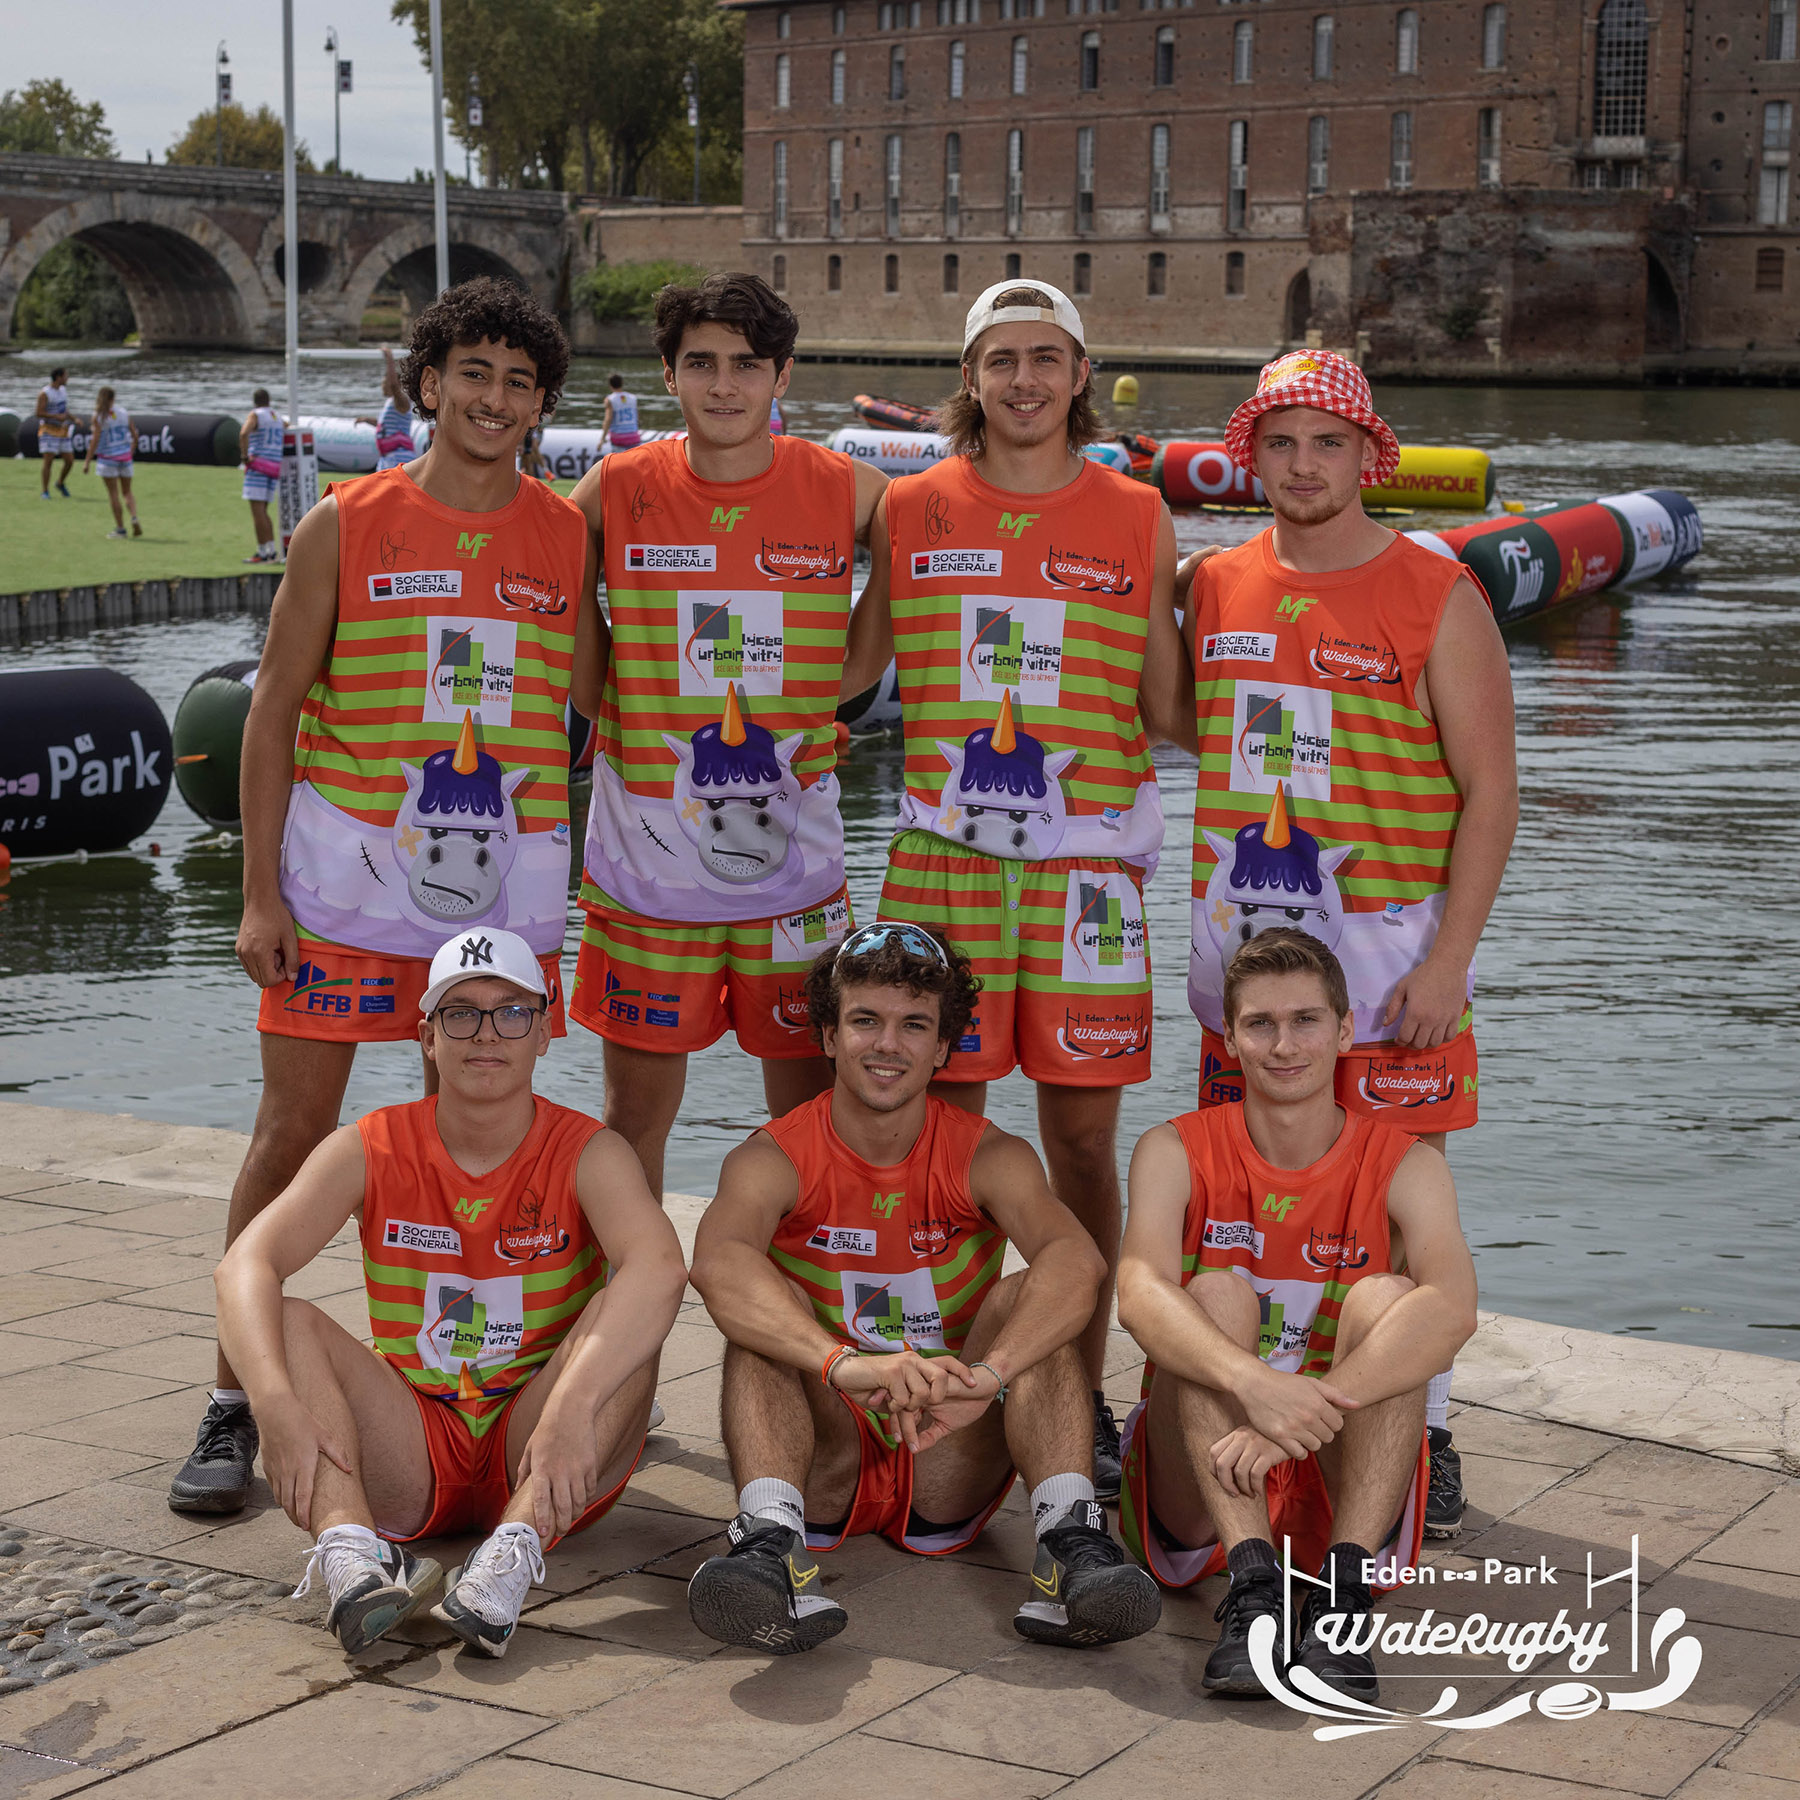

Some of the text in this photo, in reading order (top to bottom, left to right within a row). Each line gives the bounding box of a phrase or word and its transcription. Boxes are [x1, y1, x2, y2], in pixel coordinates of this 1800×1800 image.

[843, 441, 949, 459] Das WeltAu
[1381, 474, 1478, 493] OLYMPIQUE
[710, 506, 750, 532] MF
[998, 512, 1040, 538] MF
[456, 532, 493, 558] MF
[647, 548, 700, 558] SOCIETE
[777, 542, 820, 552] Eden Park
[647, 558, 712, 567] GENERALE
[769, 554, 831, 569] WateRugby
[932, 553, 985, 563] SOCIETE
[1066, 551, 1109, 566] Eden Park
[515, 572, 530, 581] Eden
[932, 563, 997, 573] GENERALE
[1055, 563, 1117, 584] WateRugby
[395, 574, 447, 585] SOCIETE
[396, 584, 458, 595] GENERALE
[1276, 595, 1319, 623] MF
[1217, 636, 1260, 646] SOCIETE
[1334, 638, 1378, 653] Eden Park
[698, 647, 744, 662] urbain
[1216, 646, 1271, 657] GENERALE
[978, 652, 1023, 669] urbain
[1322, 649, 1388, 674] WateRugby
[440, 673, 483, 690] urbain
[1249, 741, 1294, 761] urbain
[48, 730, 161, 800] Park
[1083, 931, 1125, 948] urbain
[460, 936, 493, 967] NY
[307, 992, 352, 1013] FFB
[608, 998, 640, 1021] FFB
[1085, 1014, 1131, 1023] Eden Park
[1073, 1027, 1139, 1044] WateRugby
[1386, 1063, 1431, 1071] Eden Park
[1210, 1081, 1243, 1102] FFB
[1374, 1076, 1441, 1093] WateRugby
[1463, 1072, 1478, 1094] M
[454, 1197, 494, 1223] MF
[872, 1192, 905, 1218] MF
[1261, 1193, 1302, 1222] MF
[402, 1225, 450, 1239] SOCIETE
[401, 1236, 460, 1251] GENERALE
[862, 1322, 905, 1335] urbain
[439, 1328, 485, 1348] urbain
